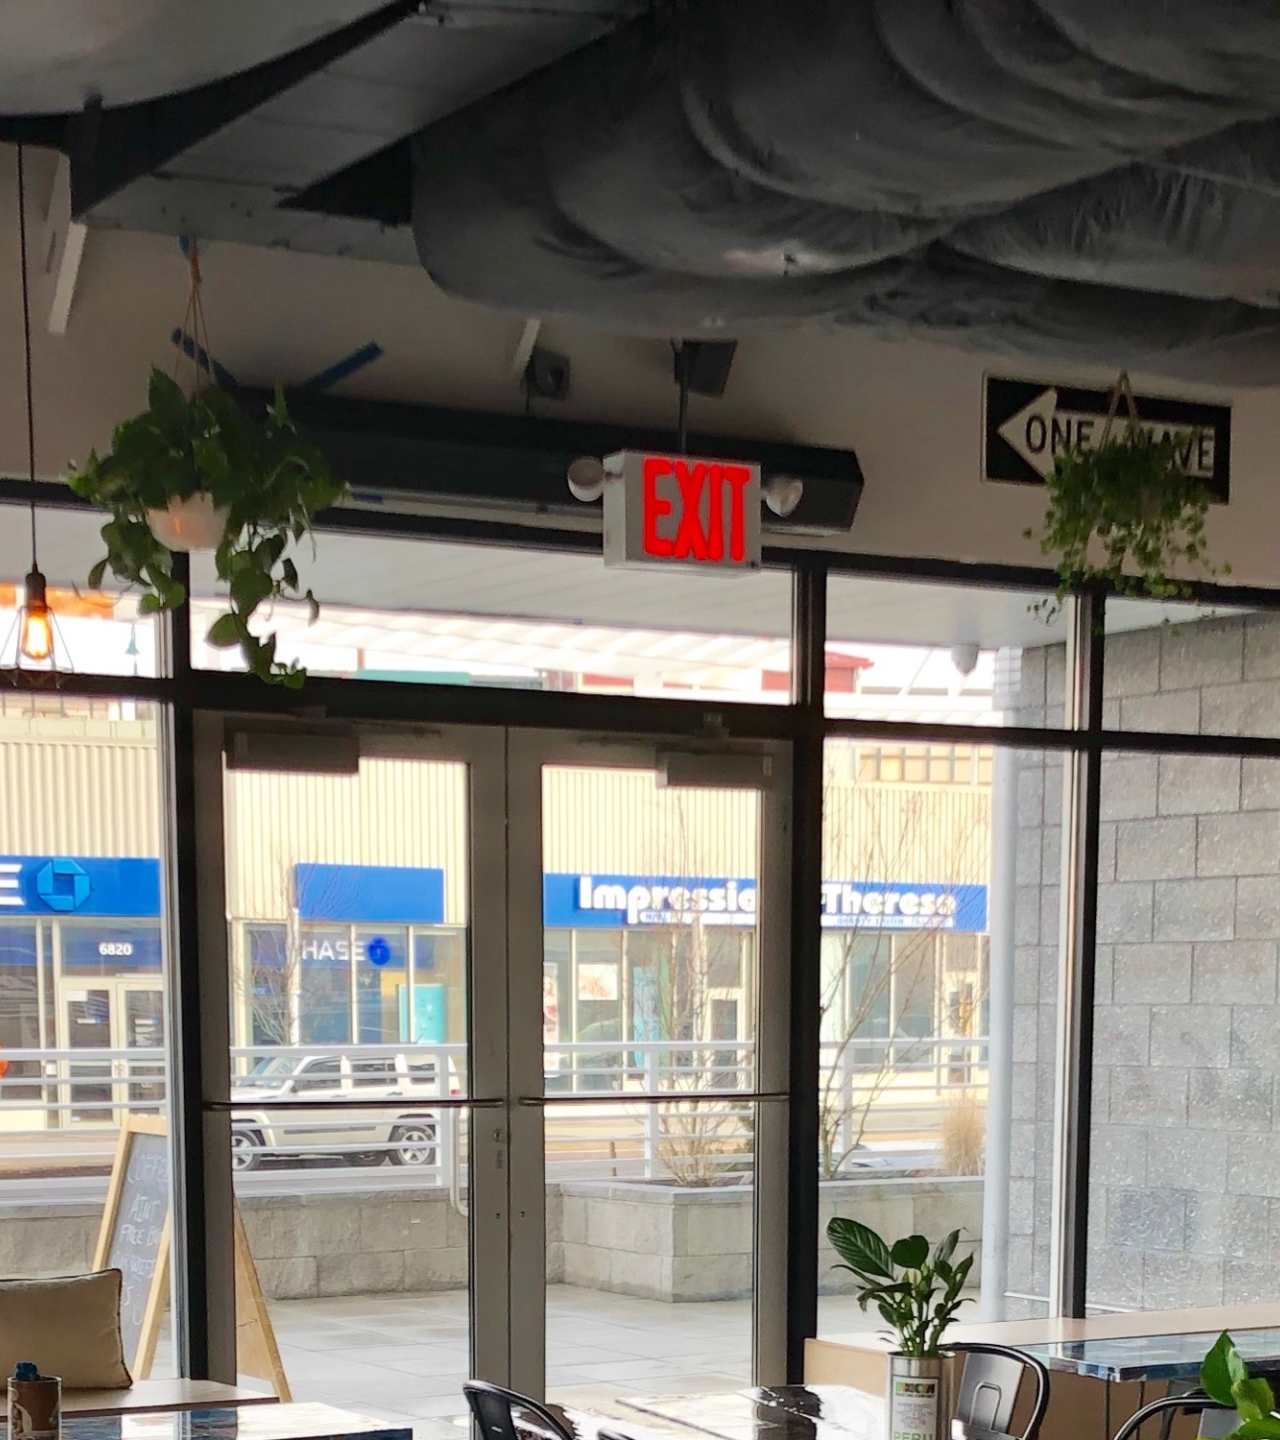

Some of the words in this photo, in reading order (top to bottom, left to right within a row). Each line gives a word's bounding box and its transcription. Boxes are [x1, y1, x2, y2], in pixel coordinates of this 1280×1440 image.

[1025, 415, 1094, 460] ONE
[642, 455, 752, 564] EXIT
[579, 876, 757, 924] Impressio
[301, 939, 367, 961] HASE
